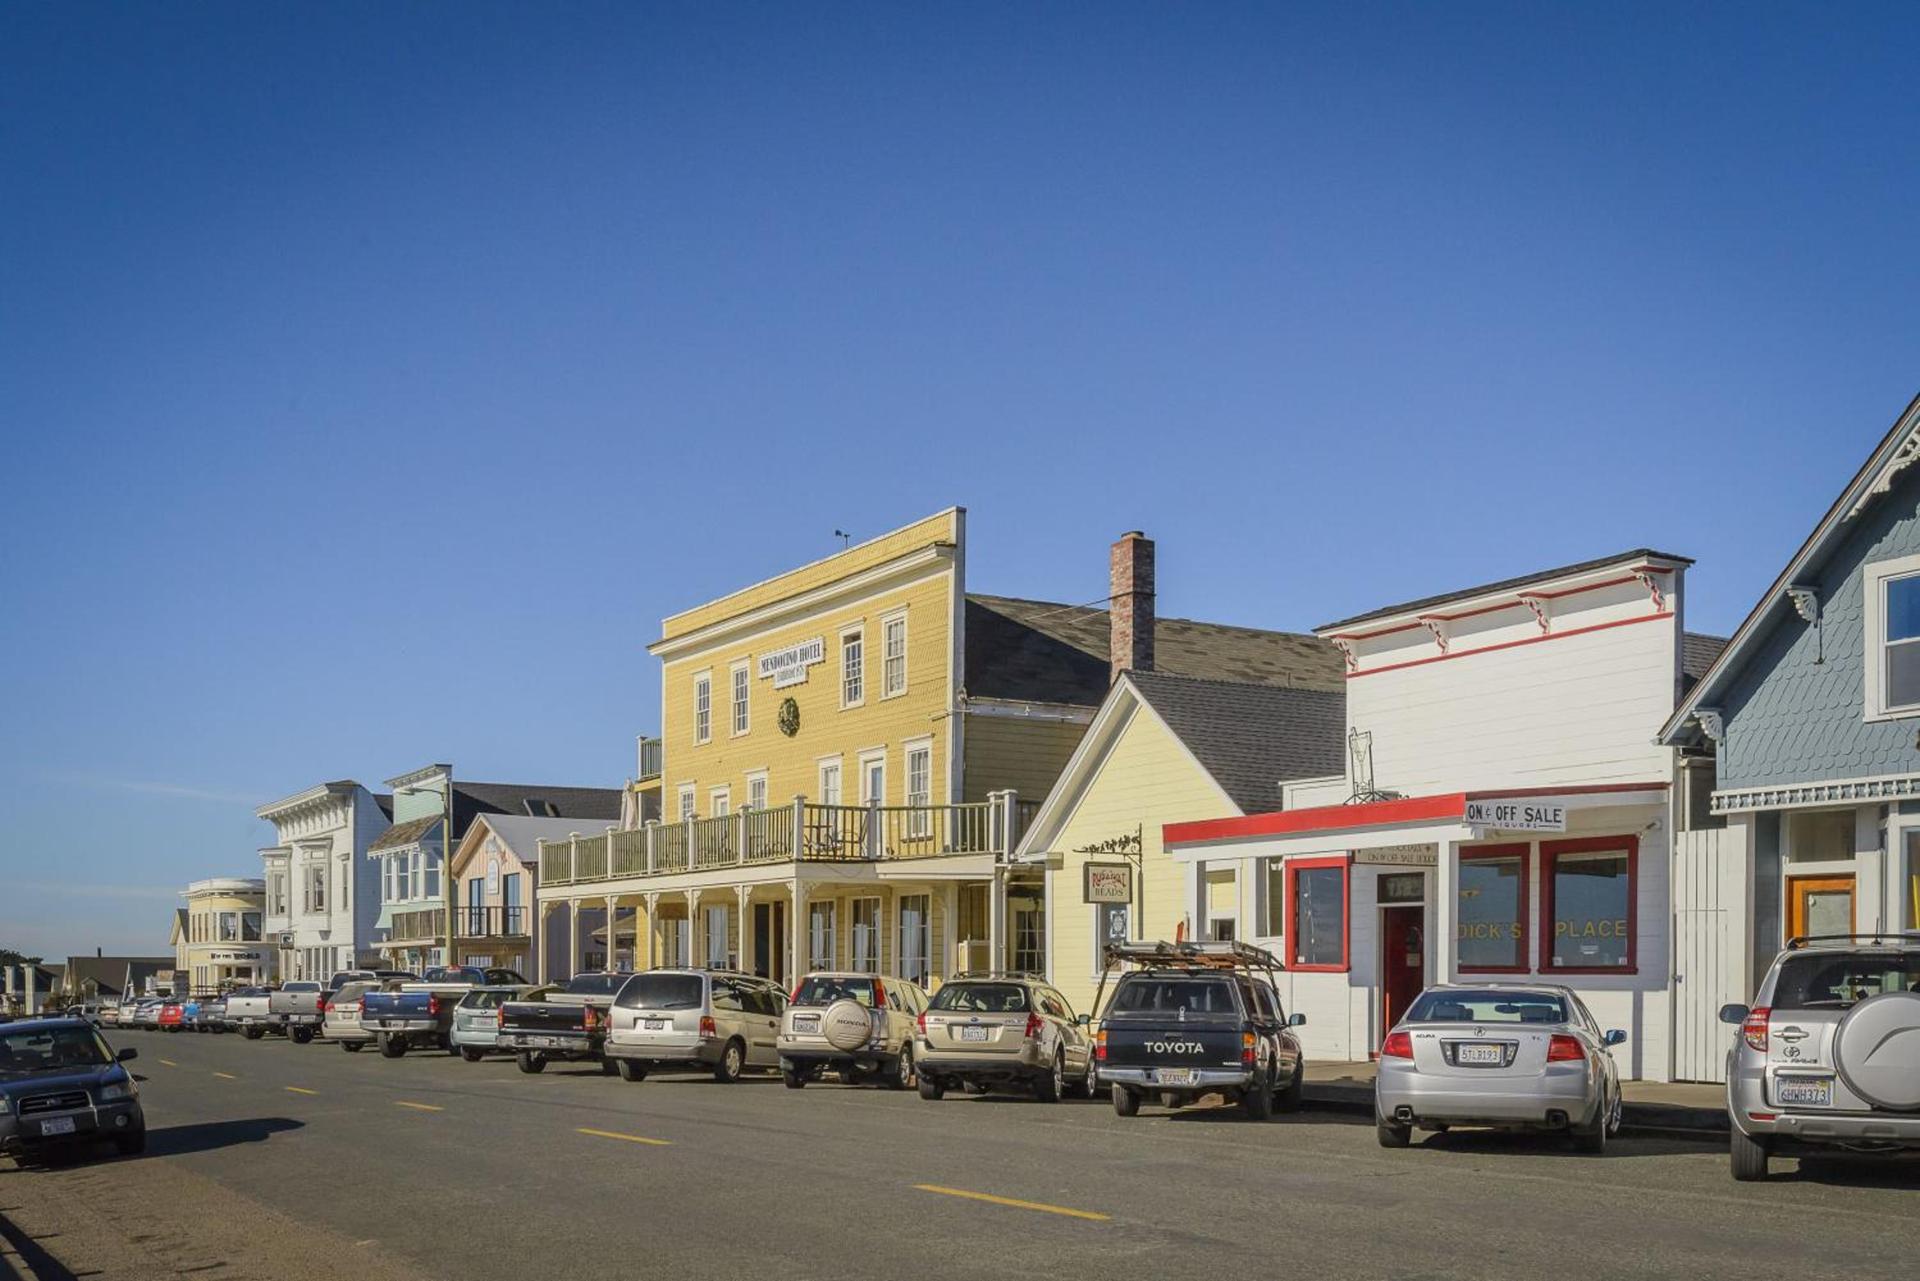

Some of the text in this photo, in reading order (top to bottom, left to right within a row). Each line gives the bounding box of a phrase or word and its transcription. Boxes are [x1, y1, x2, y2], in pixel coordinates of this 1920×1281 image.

[799, 643, 820, 662] HOTEL
[1468, 804, 1482, 819] ON
[1496, 806, 1517, 821] OFF
[1524, 807, 1562, 823] SALE
[1095, 888, 1124, 896] BEADS
[1555, 920, 1628, 938] PLACE
[837, 1019, 866, 1027] HONDA
[1144, 1042, 1204, 1053] TOYOTA
